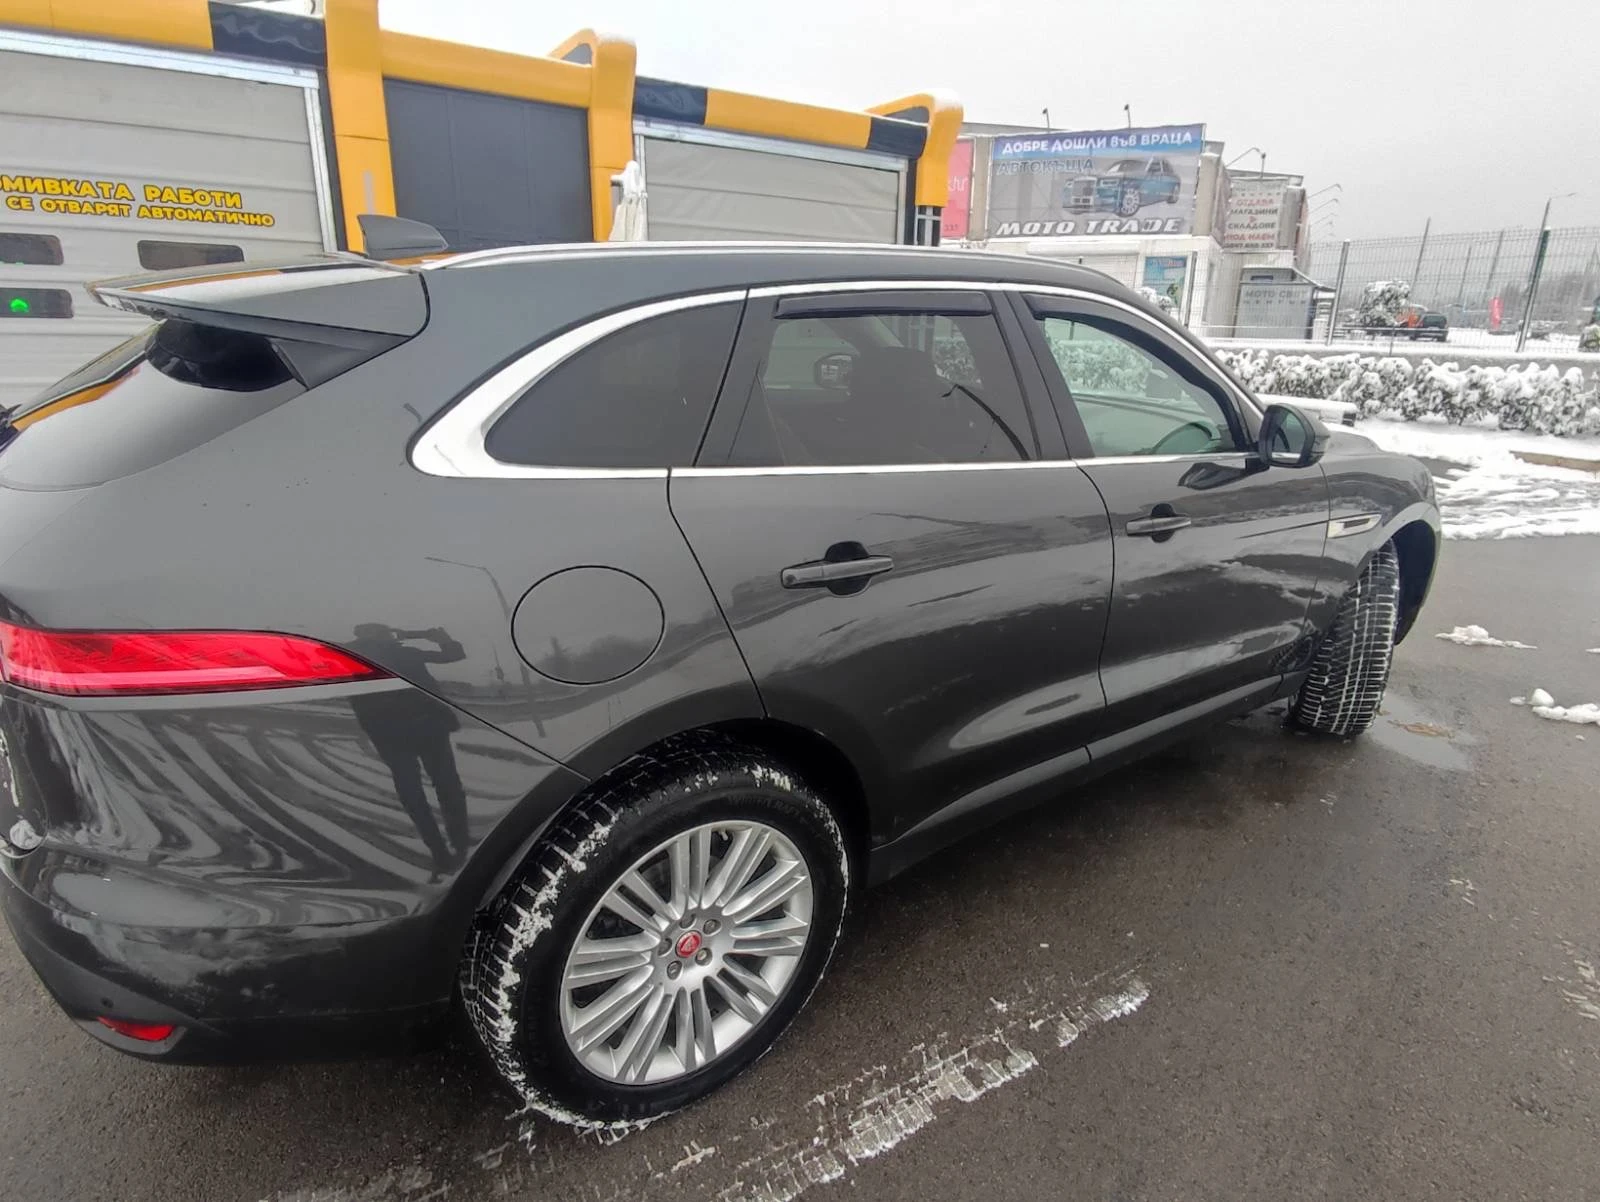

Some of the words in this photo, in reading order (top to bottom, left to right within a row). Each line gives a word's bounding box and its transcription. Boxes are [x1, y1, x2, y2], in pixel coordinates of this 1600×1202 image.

[1002, 140, 1048, 155] ДОБРЕ
[1051, 137, 1107, 152] ДОШЛИ
[1140, 131, 1192, 147] ВРАЦА
[0, 175, 135, 201] МИВКАТА
[144, 184, 242, 209] РАБОТИ
[6, 195, 34, 211] СЕ
[40, 198, 131, 217] ОТВАРЯТ
[137, 204, 275, 227] АВТОМАТИЧНО
[995, 220, 1077, 236] MOTO
[1086, 218, 1184, 234] TRADE
